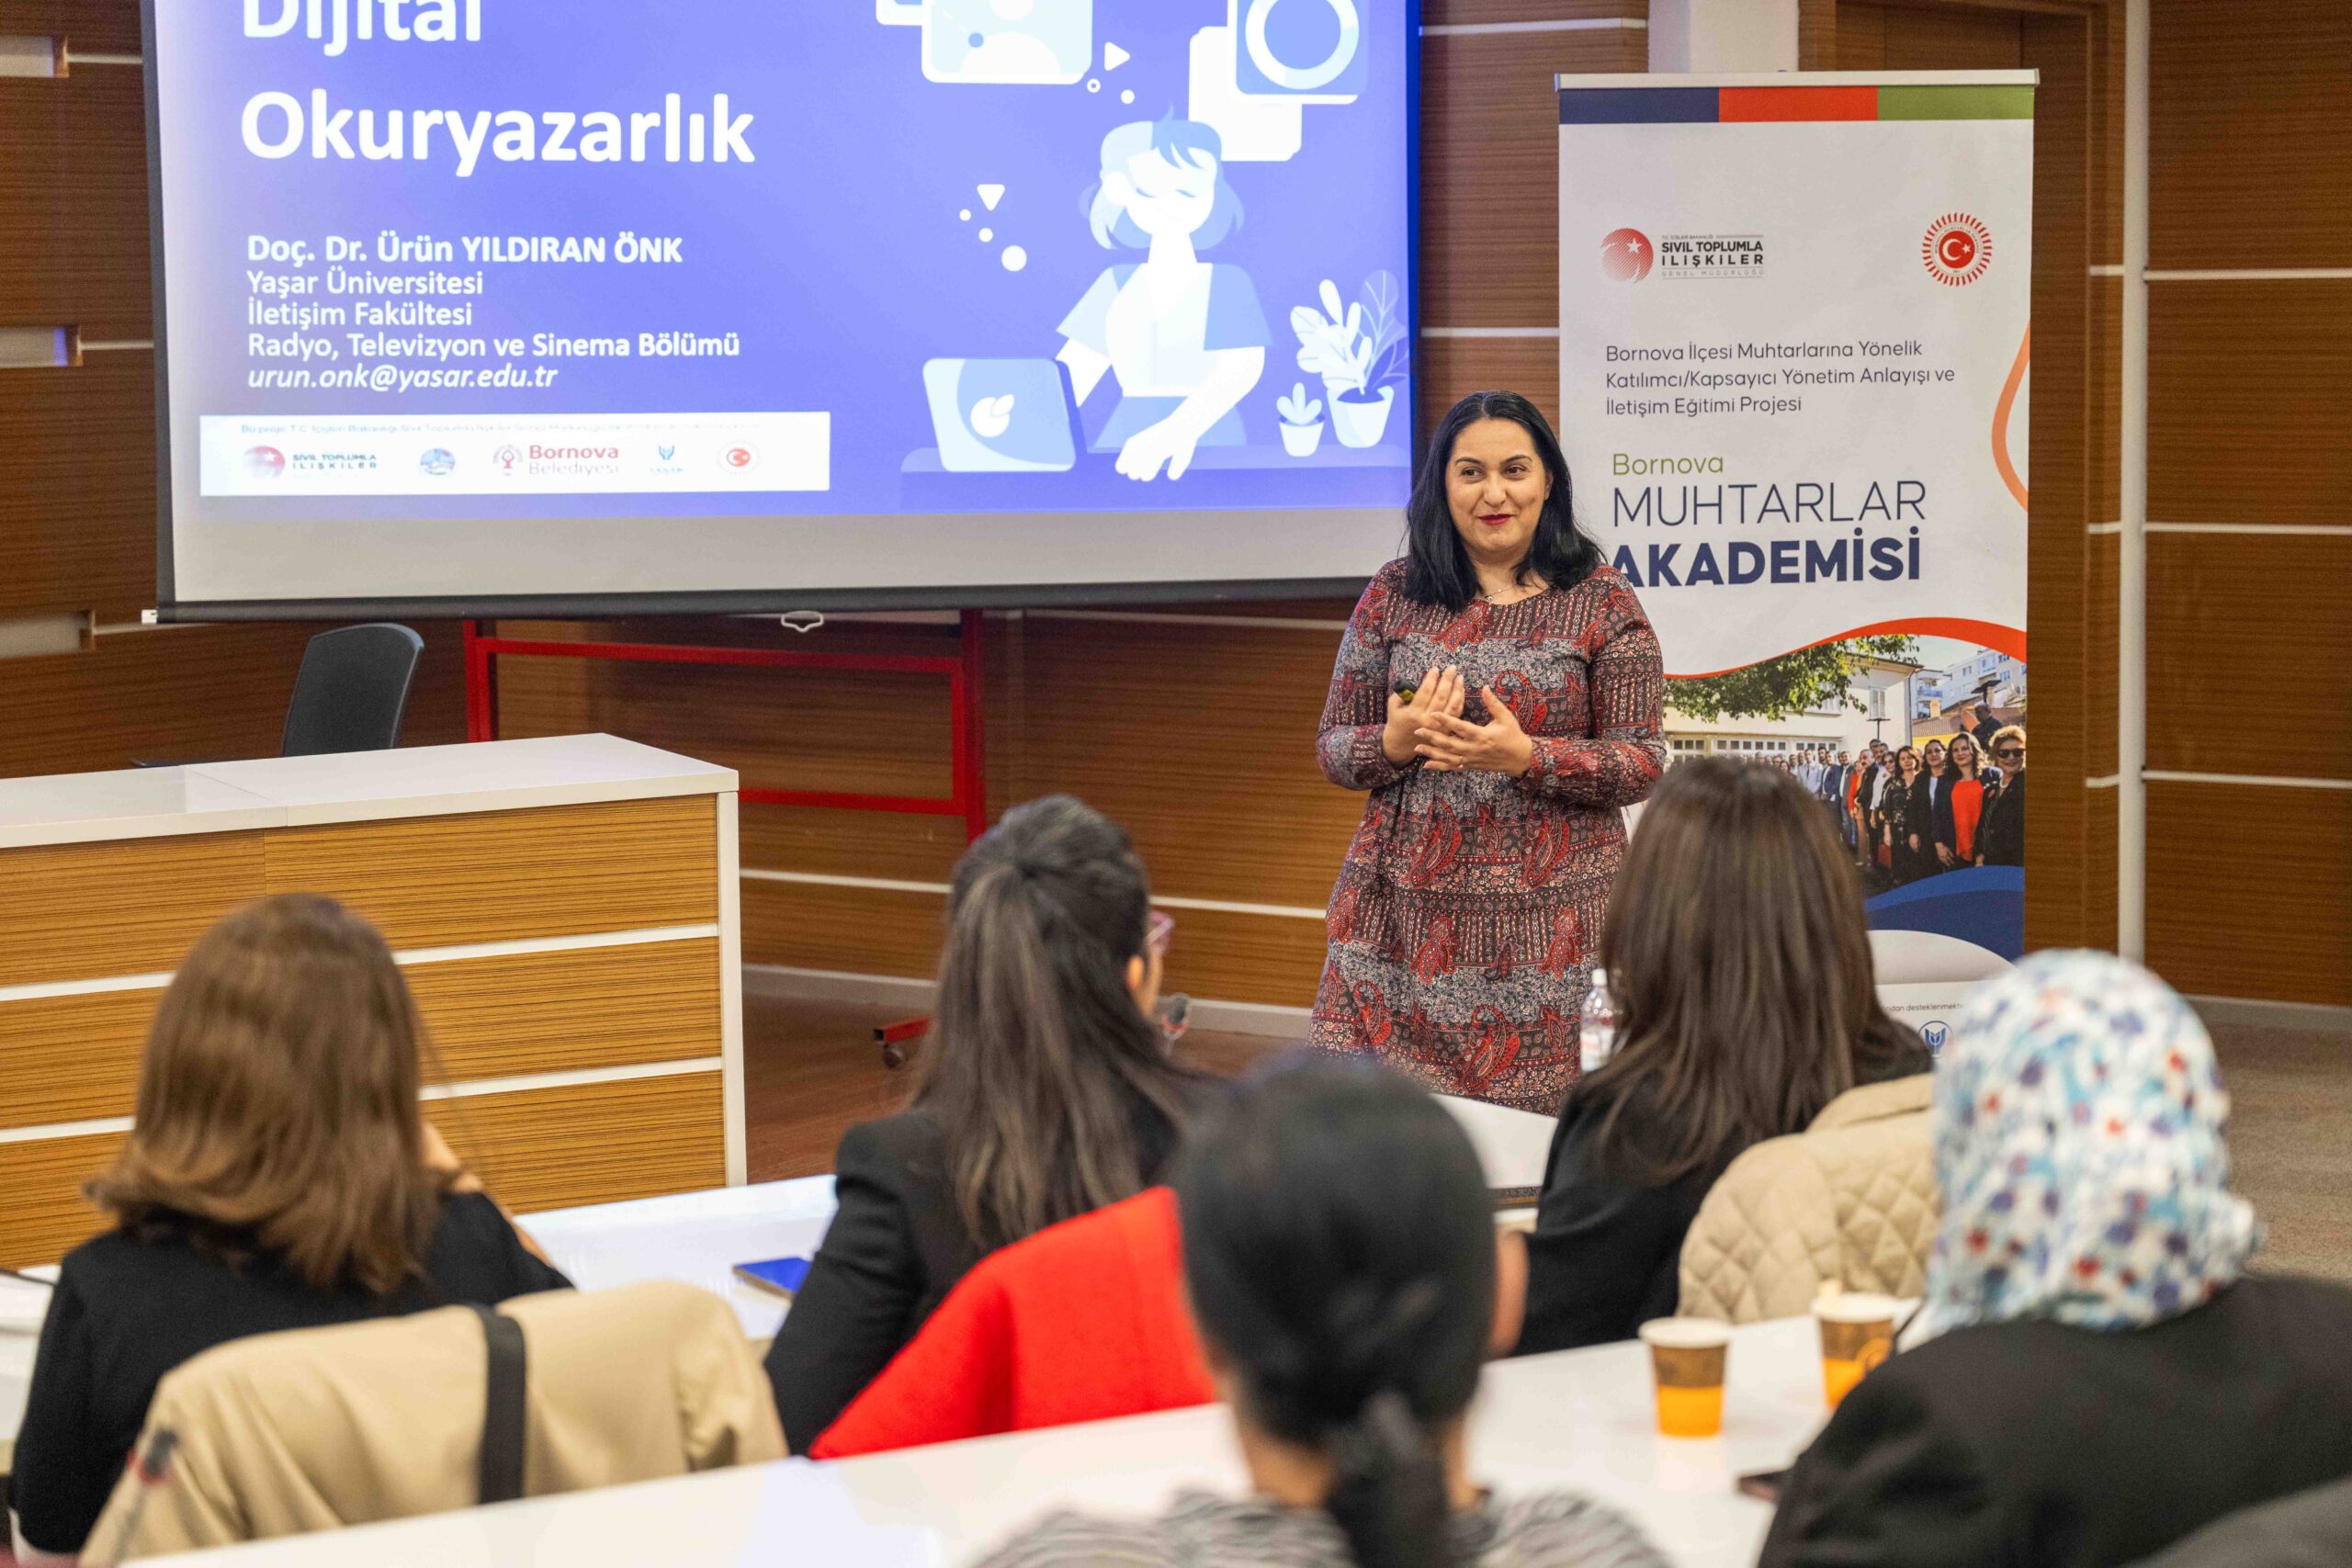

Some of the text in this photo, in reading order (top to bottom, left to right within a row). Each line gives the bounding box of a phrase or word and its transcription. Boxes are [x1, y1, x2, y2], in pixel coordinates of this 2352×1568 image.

[240, 87, 756, 178] Okuryazarlık
[247, 230, 684, 268] Doç. Dr. Ürün YILDIRAN ÖNK
[1695, 241, 1763, 253] TOPLUMLA
[246, 265, 483, 299] Yaşar Üniversitesi
[247, 296, 472, 331] İletişim Fakültesi
[248, 331, 740, 362] Radyo, Televizyon ve Sinema Bölümü
[1606, 340, 1923, 363] Bornova İlçesi Muhtarlarına Yönelik
[247, 362, 559, 392] urun.onk@yasar.edu.tr
[1606, 367, 1955, 390] Katılımcı/Kapsayıcı Yönetim Anlayışı ve
[1606, 396, 1802, 418] İletişim Eğitimi Projesi
[529, 445, 619, 460] Bornova
[1612, 453, 1724, 477] Bornova
[1612, 479, 1927, 528] MUHTARLAR
[1612, 525, 1922, 588] AKADEMİSİ
